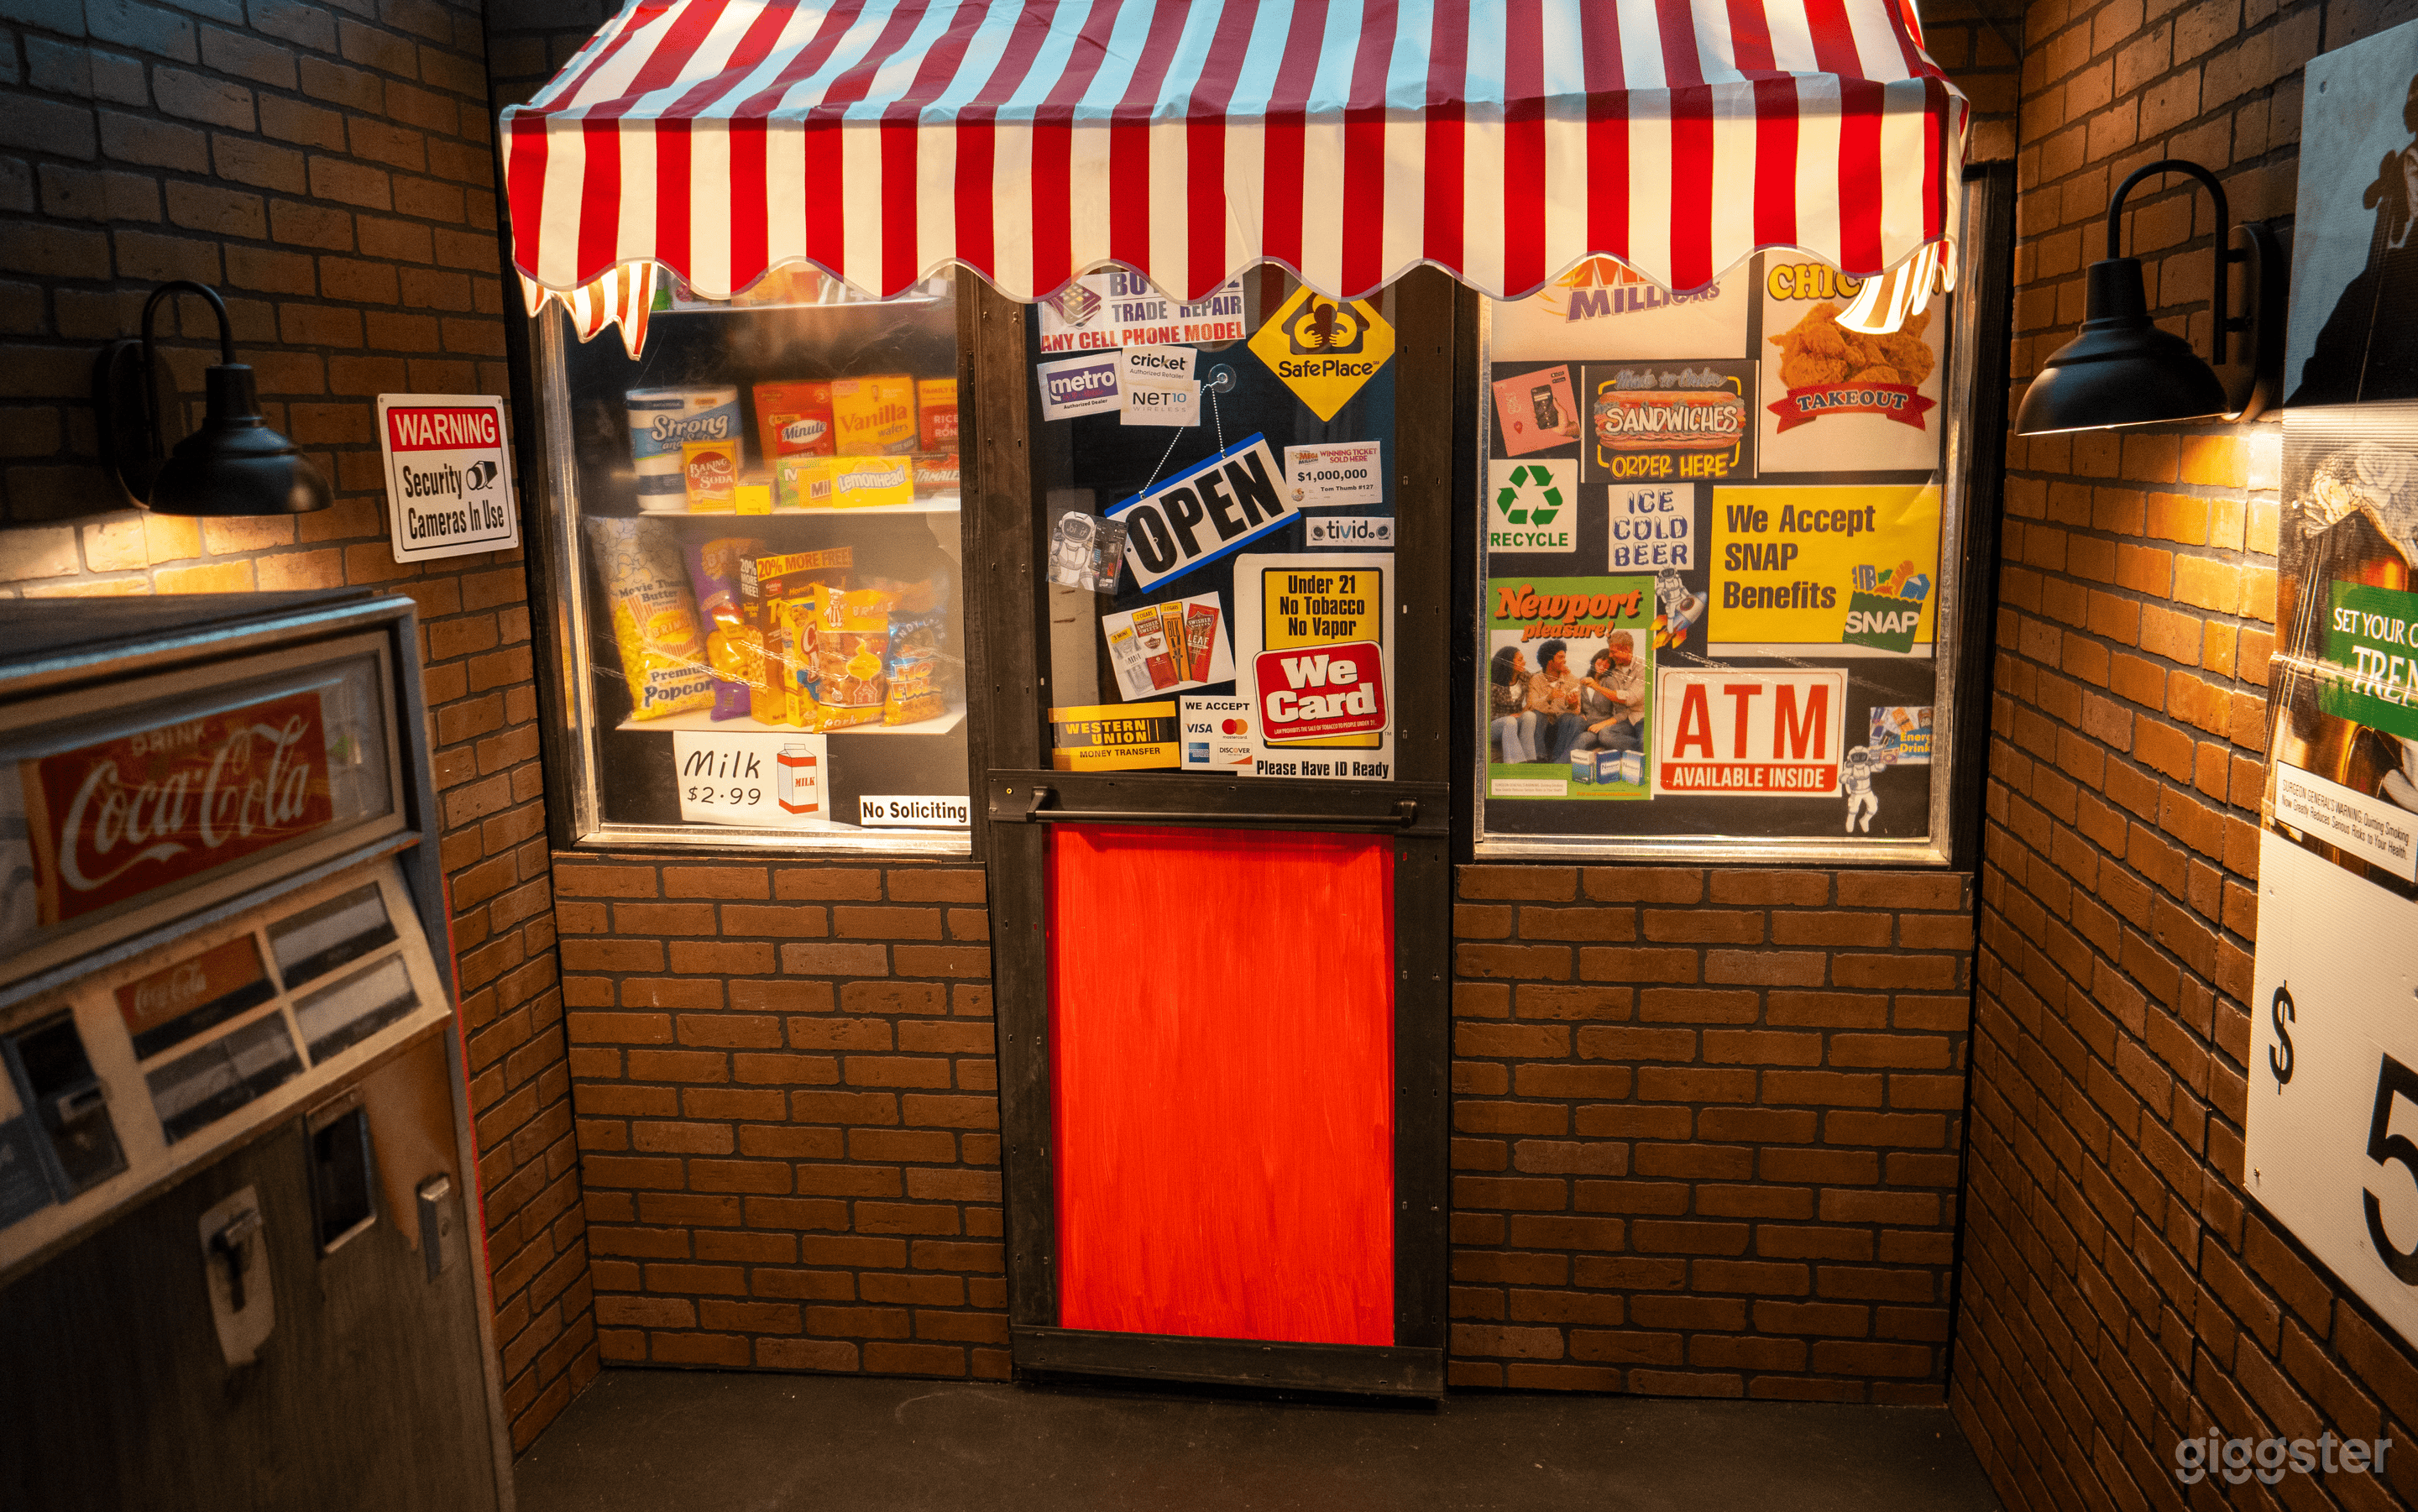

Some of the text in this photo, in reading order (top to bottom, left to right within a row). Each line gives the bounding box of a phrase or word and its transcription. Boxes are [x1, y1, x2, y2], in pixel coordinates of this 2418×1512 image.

[1109, 272, 1162, 296] BU
[1112, 301, 1168, 322] TRADE
[1040, 322, 1245, 352] ANY CELL PHONE MODEL
[1129, 368, 1185, 379] Authorized Retailer
[1131, 354, 1186, 371] cricket
[1279, 359, 1374, 378] Safe Place
[1050, 370, 1115, 395] metro
[1797, 390, 1908, 411] TAKEOUT
[395, 413, 496, 446] WARNING
[652, 414, 729, 441] Strong
[840, 404, 908, 433] Vanilla
[1605, 406, 1739, 432] SANDWICHES
[782, 421, 827, 441] Minute
[934, 428, 958, 437] RON
[689, 458, 728, 478] BAKING
[1297, 468, 1368, 483] $1,000,000
[1611, 453, 1730, 479] ORDER HERE
[403, 463, 462, 500] Security
[699, 474, 733, 489] SODA
[1126, 450, 1285, 573] OPEN
[1627, 489, 1674, 514] ICE
[408, 500, 505, 540] Cameras In Use
[1613, 515, 1688, 540] COLD
[1726, 505, 1876, 537] We Accept
[1490, 532, 1568, 547] RECYCLE
[758, 558, 782, 578] 20%
[785, 552, 820, 572] MORE
[1614, 541, 1688, 567] BEER
[1725, 543, 1798, 571] SNAP
[740, 558, 757, 575] 20%
[619, 583, 653, 599] Movie
[1288, 575, 1356, 594] Under 21
[1723, 581, 1837, 609] Benefits
[1280, 596, 1365, 615] No Tobacco
[1493, 583, 1643, 625] Newport
[1288, 617, 1356, 639] No Vapor
[1520, 620, 1615, 642] pleasure!
[1845, 611, 1920, 634] SNAP
[2333, 607, 2360, 634] SET
[2362, 612, 2405, 645] YOUR
[1188, 634, 1210, 645] LEAF
[1280, 654, 1358, 689] We
[1206, 703, 1250, 711] ACCEPT
[1266, 682, 1378, 723] Card
[1065, 719, 1146, 735] WESTERN
[1185, 723, 1212, 733] VISA
[1672, 684, 1829, 759] ATM
[1091, 731, 1147, 745] UNION
[1080, 747, 1160, 758] MONEY TRANSFER
[684, 751, 761, 778] Milk
[1256, 761, 1390, 779] Please Have ID Ready
[795, 777, 815, 787] MILK
[1672, 767, 1825, 788] AVAILABLE INSIDE
[60, 714, 310, 891] Coca-Cola
[687, 786, 762, 806] $2.99
[863, 801, 966, 823] No Soliciting
[2282, 779, 2306, 798] SURGEON
[2307, 789, 2335, 812] GENERAL'S
[2335, 798, 2363, 824] WARNING:
[2385, 822, 2409, 846] Smoking
[2282, 794, 2292, 808] Now
[2292, 798, 2309, 818] Greatly
[2310, 806, 2330, 825] Reduces
[2332, 815, 2349, 834] Serious
[2351, 824, 2365, 841] Risks
[2367, 833, 2373, 845] to
[2374, 834, 2386, 850] Your
[2269, 980, 2296, 1096] $
